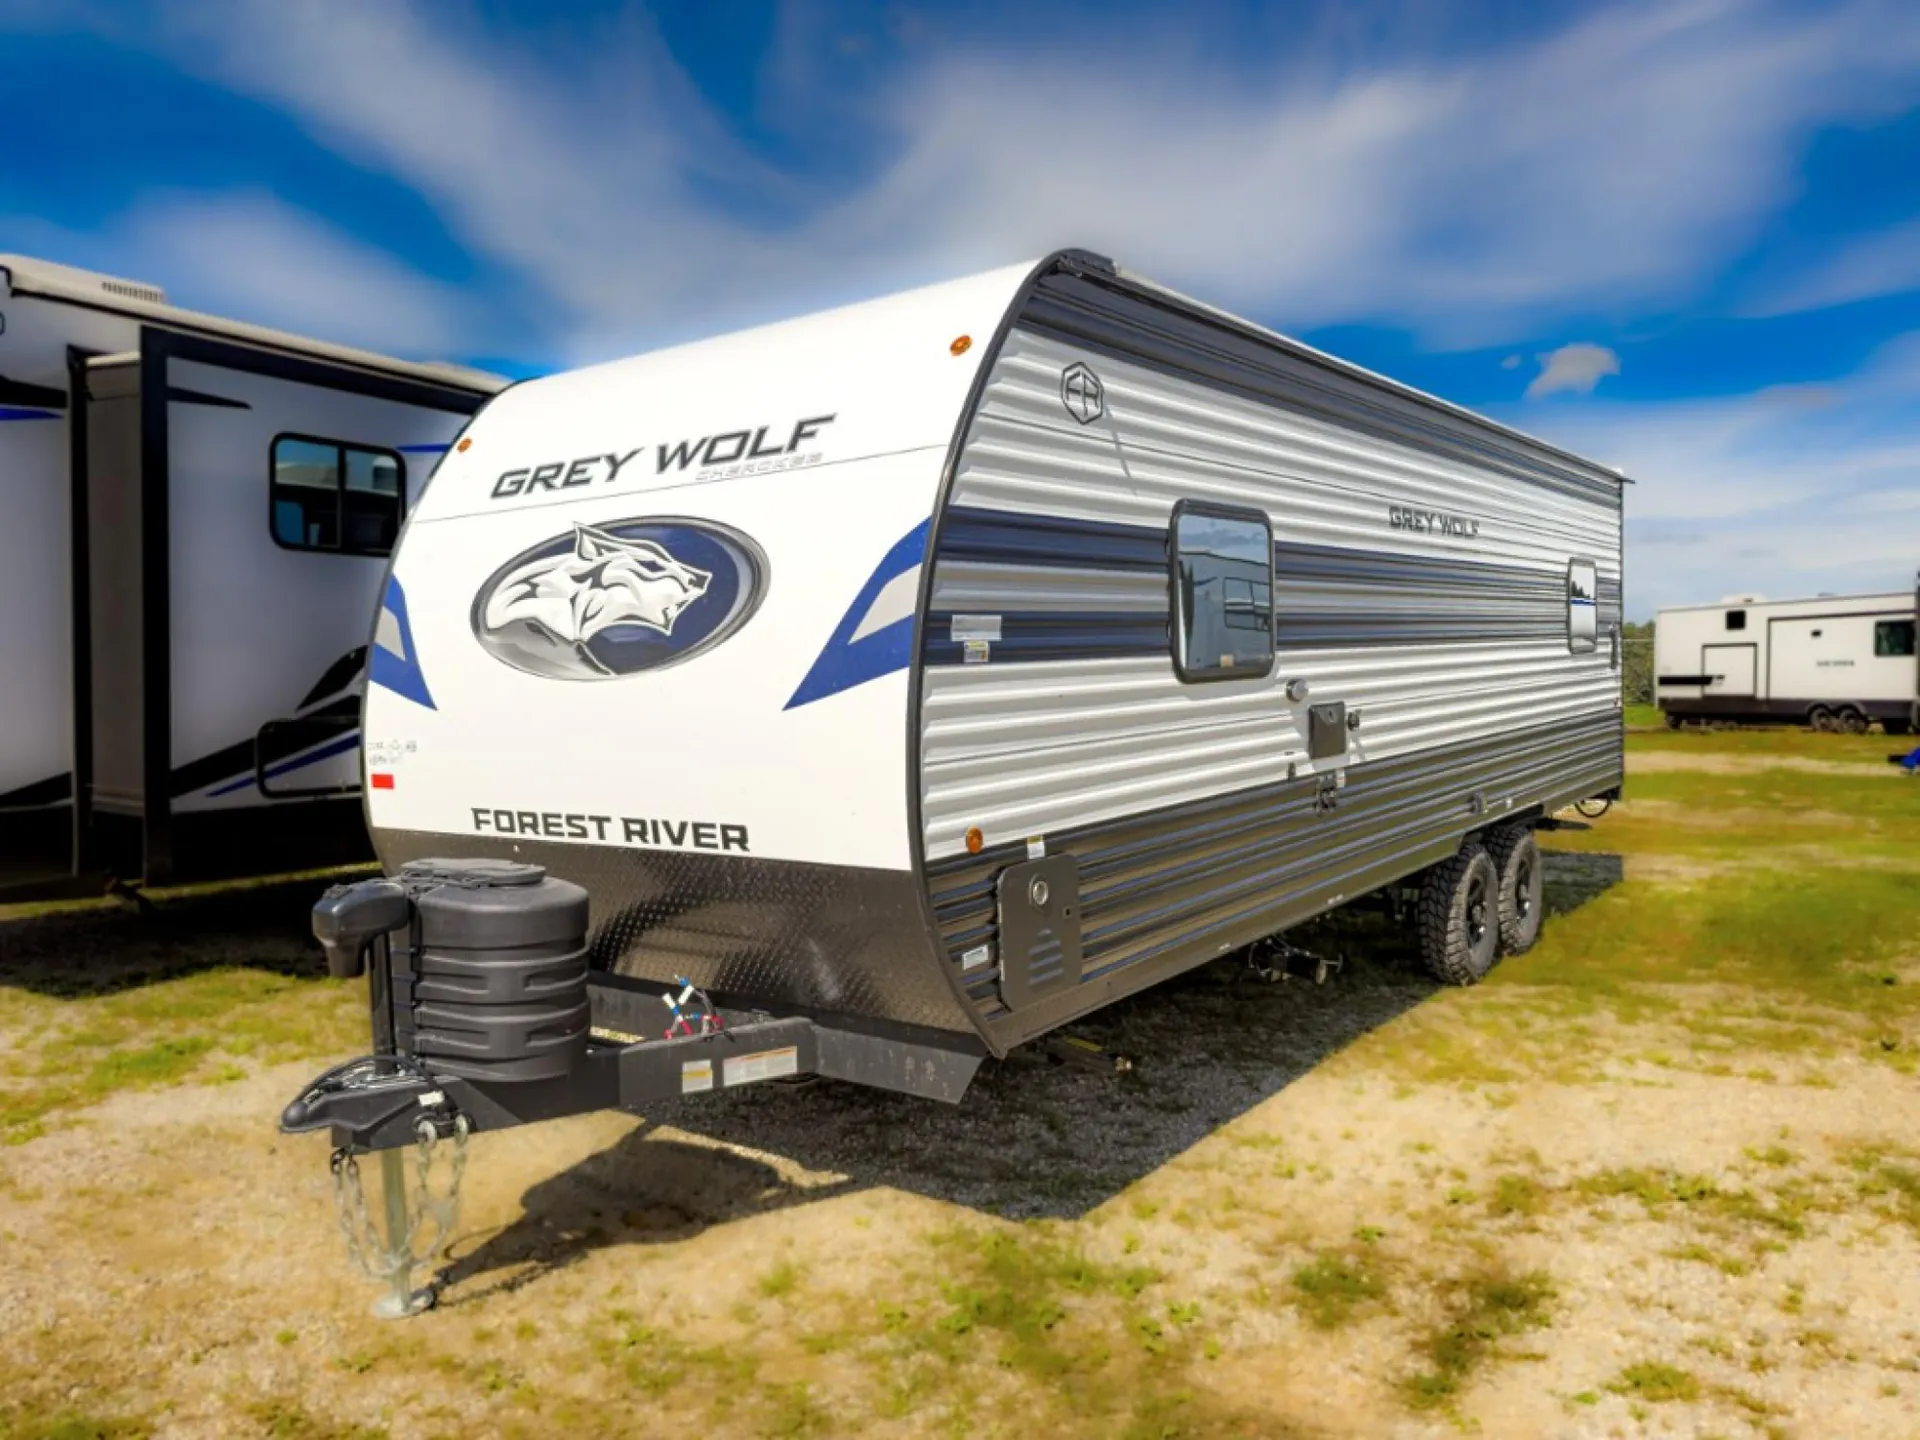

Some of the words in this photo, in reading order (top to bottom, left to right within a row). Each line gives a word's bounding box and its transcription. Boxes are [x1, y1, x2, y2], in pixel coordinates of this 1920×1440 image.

[490, 446, 645, 499] GREY
[656, 412, 837, 475] WOLF
[1389, 506, 1435, 534] GREY
[1437, 513, 1480, 540] WOLF
[471, 807, 612, 841] FOREST
[621, 816, 751, 852] RIVER
